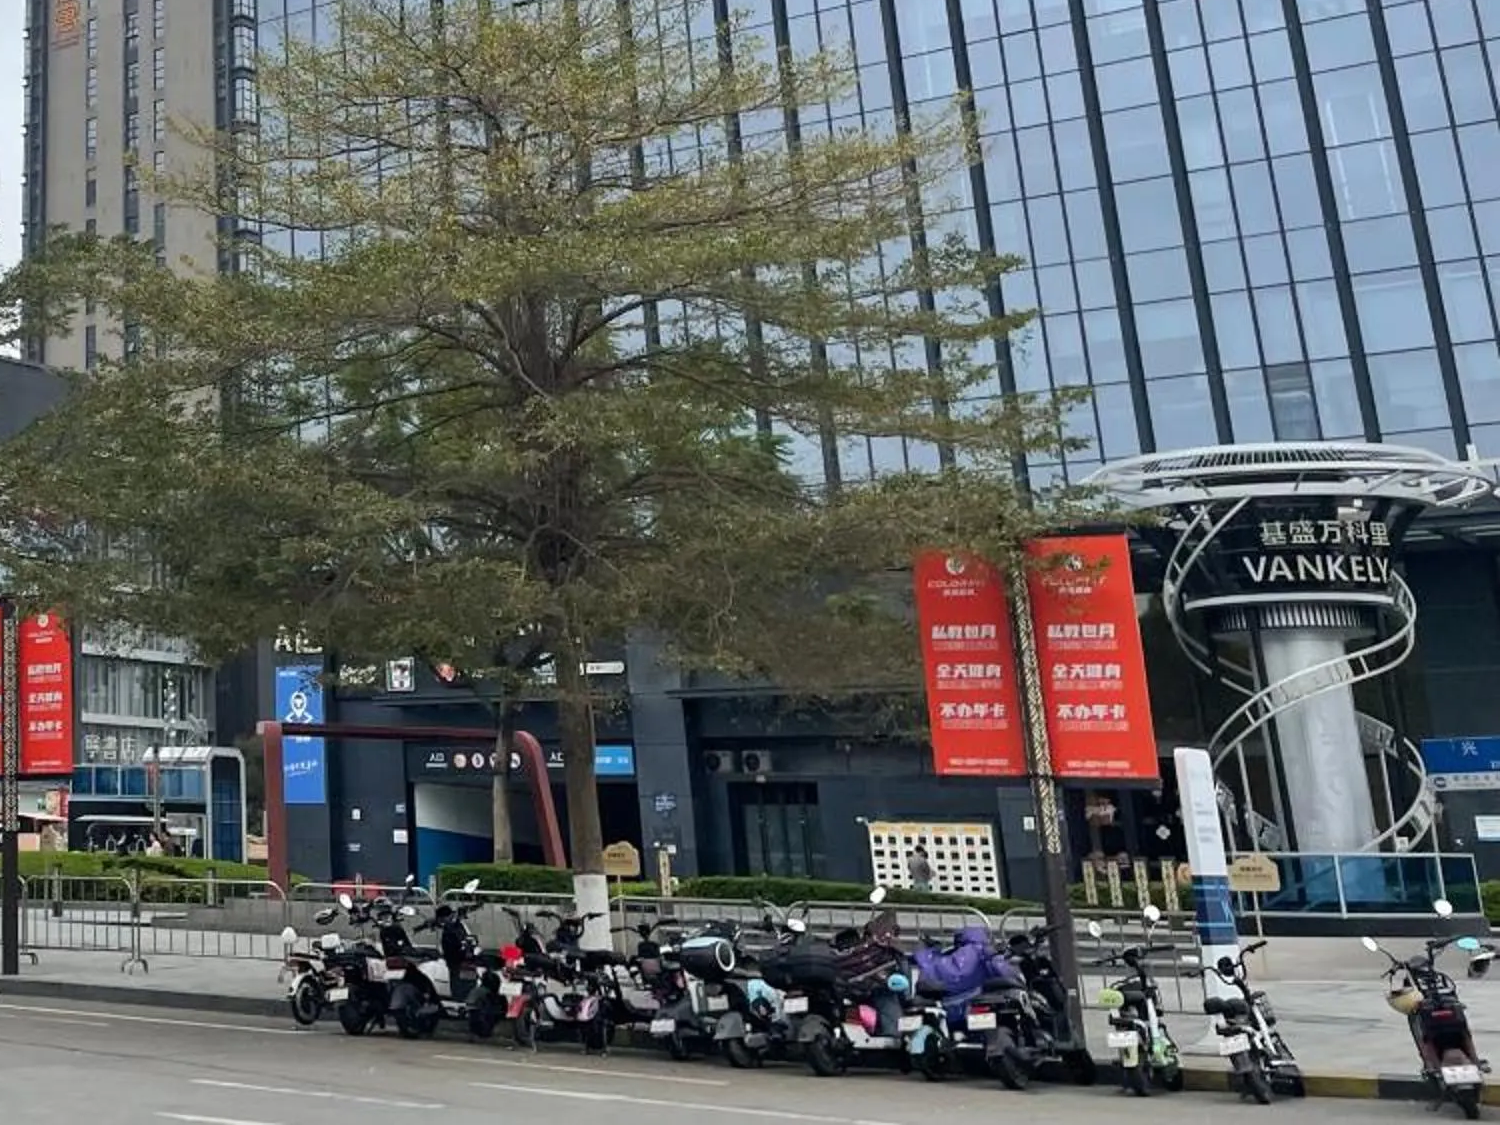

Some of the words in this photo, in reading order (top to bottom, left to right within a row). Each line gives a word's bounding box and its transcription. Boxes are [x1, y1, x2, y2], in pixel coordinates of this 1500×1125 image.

[1260, 519, 1391, 546] 基盛万科里
[1242, 555, 1389, 583] VANKELY
